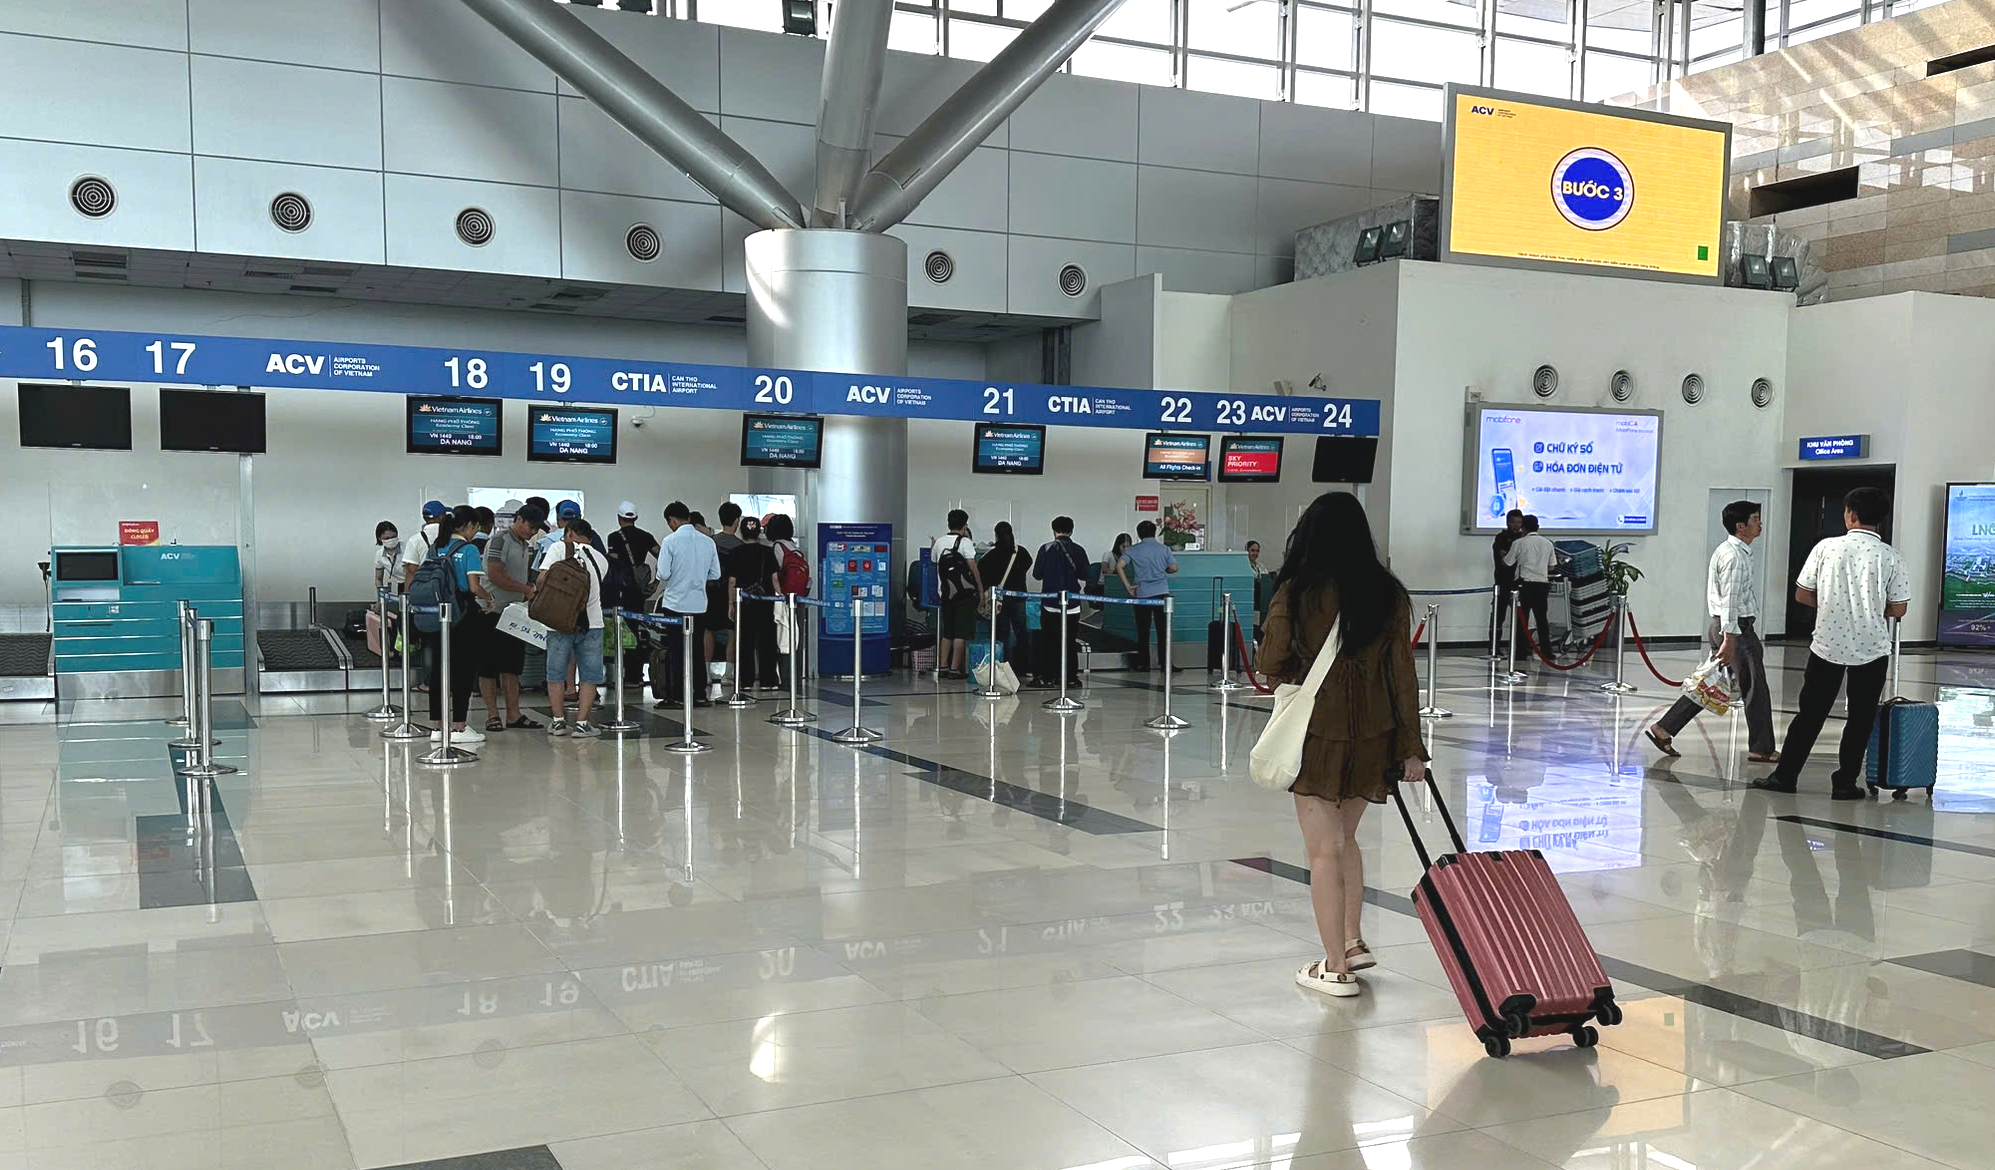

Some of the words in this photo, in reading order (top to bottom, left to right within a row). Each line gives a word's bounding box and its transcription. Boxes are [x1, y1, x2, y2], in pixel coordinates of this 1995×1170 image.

[1471, 106, 1494, 115] ACV
[1562, 180, 1609, 200] BƯỚC
[1613, 187, 1624, 201] 3
[46, 337, 98, 371] 16
[145, 341, 196, 374] 17
[266, 353, 325, 375] ACV
[333, 356, 366, 364] AIRPORTS
[333, 363, 380, 371] CORPORATION
[444, 357, 488, 389] 18
[529, 361, 572, 393] 19
[611, 371, 667, 392] CTIA
[671, 381, 718, 389] INTERNATIONAL
[754, 375, 793, 404] 20
[846, 385, 891, 404] ACV
[983, 387, 1013, 415] 21
[1047, 396, 1091, 414] CTIA
[1160, 396, 1192, 423] 22
[1216, 400, 1246, 425] 23
[1250, 405, 1286, 422] ACV
[1323, 403, 1353, 428] 24
[1486, 415, 1521, 423] mobifone
[1547, 442, 1565, 453] CHỮ
[1567, 442, 1579, 453] KÝ
[1580, 441, 1594, 453] SỐ
[1546, 461, 1565, 472] HÓA
[1566, 462, 1586, 473] ĐƠN
[1588, 462, 1609, 475] ĐIỆN
[1611, 462, 1623, 474] TỬ
